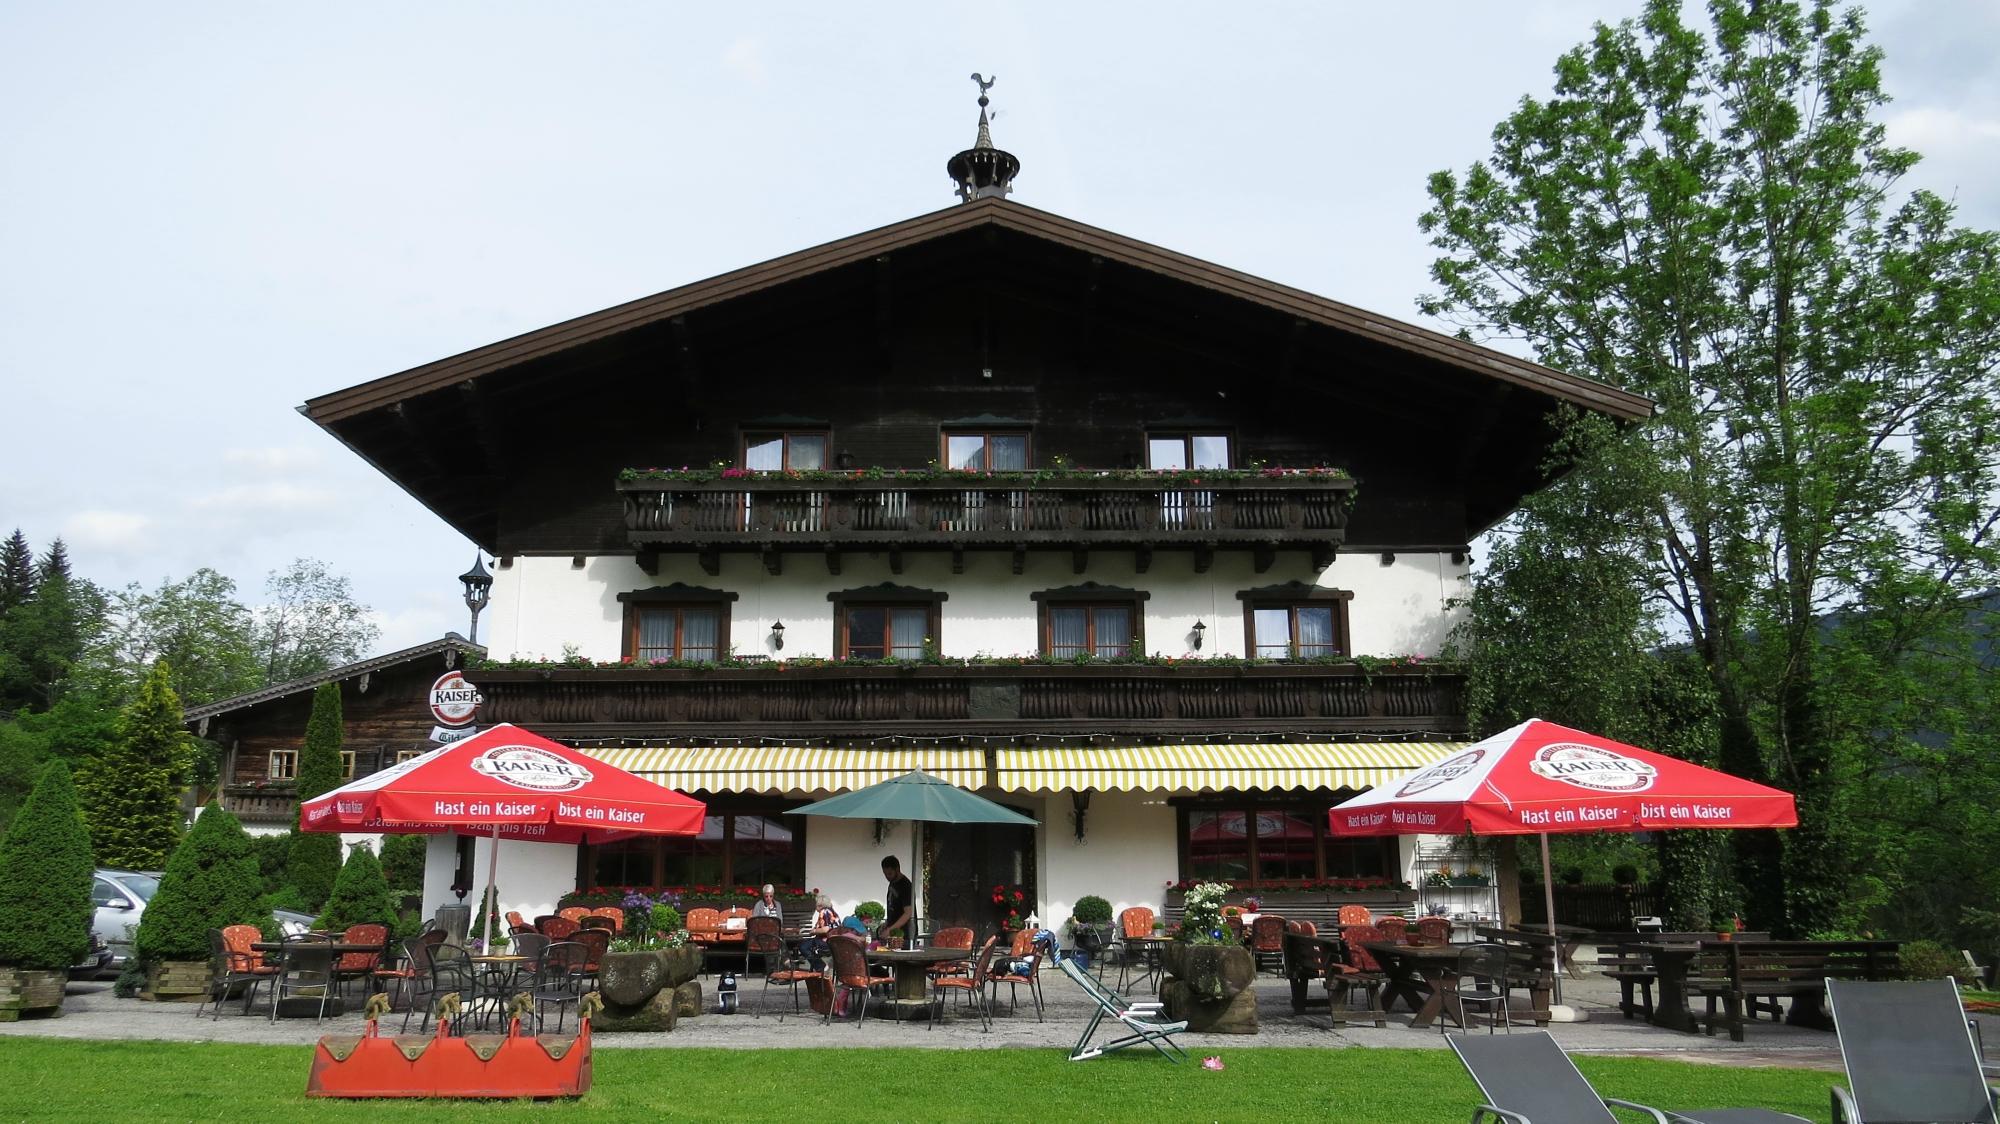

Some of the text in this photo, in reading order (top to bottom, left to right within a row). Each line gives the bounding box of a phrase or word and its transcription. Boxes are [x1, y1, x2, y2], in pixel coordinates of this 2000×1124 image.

[435, 690, 479, 704] KAISER
[493, 760, 573, 776] KAISER
[1549, 760, 1636, 774] KAISER
[435, 801, 465, 815] Hast
[469, 801, 490, 815] ein
[496, 802, 536, 815] Kaiser
[558, 802, 582, 817] bist
[585, 805, 604, 820] ein
[608, 807, 645, 823] Kaiser
[1347, 815, 1360, 827] Hast
[1360, 813, 1369, 826] ein
[1392, 809, 1405, 823] bist
[1407, 810, 1416, 824] ein
[1418, 811, 1436, 825] Kaiser
[1521, 810, 1550, 824] Hast
[1554, 807, 1575, 822] ein
[1579, 805, 1618, 821] Kaiser
[1641, 802, 1666, 818] bist
[1669, 804, 1690, 818] ein
[1693, 804, 1731, 819] Kaiser
